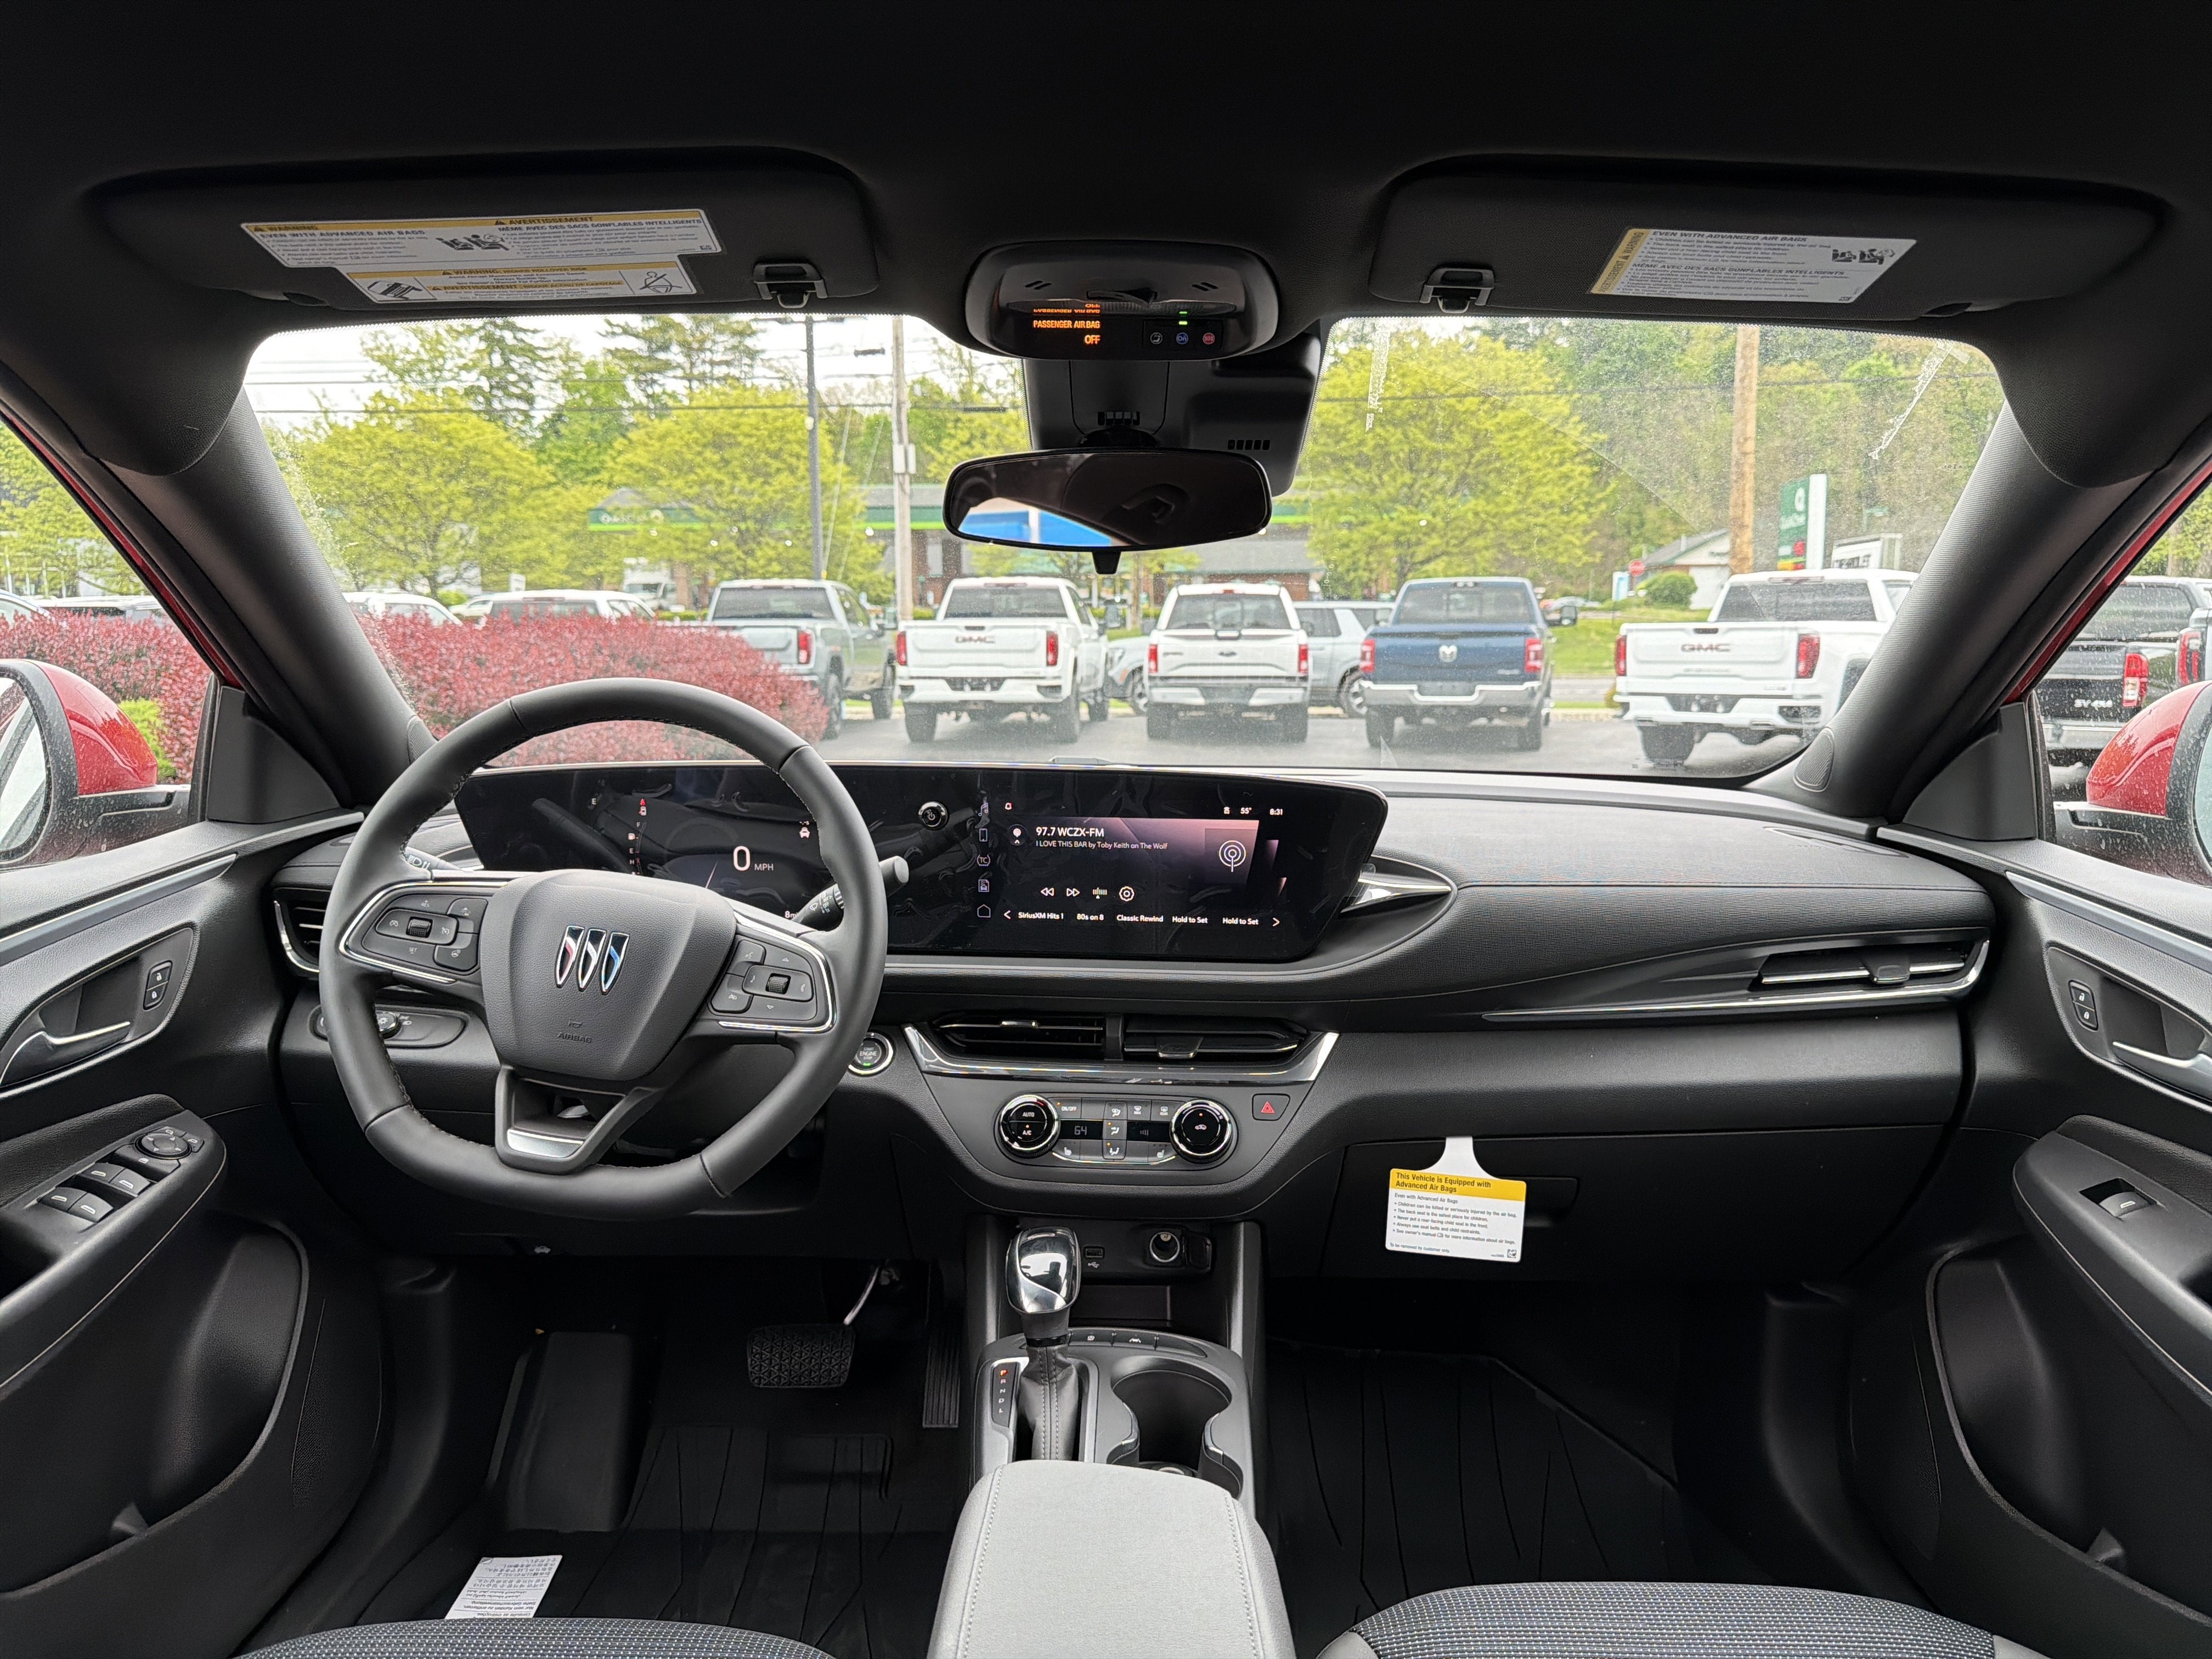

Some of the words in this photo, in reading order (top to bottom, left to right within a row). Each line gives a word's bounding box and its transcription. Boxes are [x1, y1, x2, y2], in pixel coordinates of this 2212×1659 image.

[1622, 233, 1644, 254] WARNING
[1033, 320, 1072, 328] PASSENGER
[1074, 320, 1086, 329] AIR
[1086, 320, 1101, 329] BAG
[1085, 335, 1101, 345] OFF
[955, 635, 996, 644] GMC
[1681, 644, 1730, 652] GMC
[1036, 827, 1056, 836] 97.7
[1058, 827, 1104, 837] WCZX-FM
[1088, 841, 1096, 850] by
[1097, 842, 1113, 850] Toby
[733, 845, 751, 871] 0
[557, 1032, 592, 1043] AIRBAG
[1074, 1125, 1087, 1136] 64
[1412, 1173, 1435, 1183] Vehicle
[1444, 1177, 1475, 1187] Equipped
[1396, 1181, 1427, 1190] Advanced
[1440, 1185, 1457, 1193] Bags
